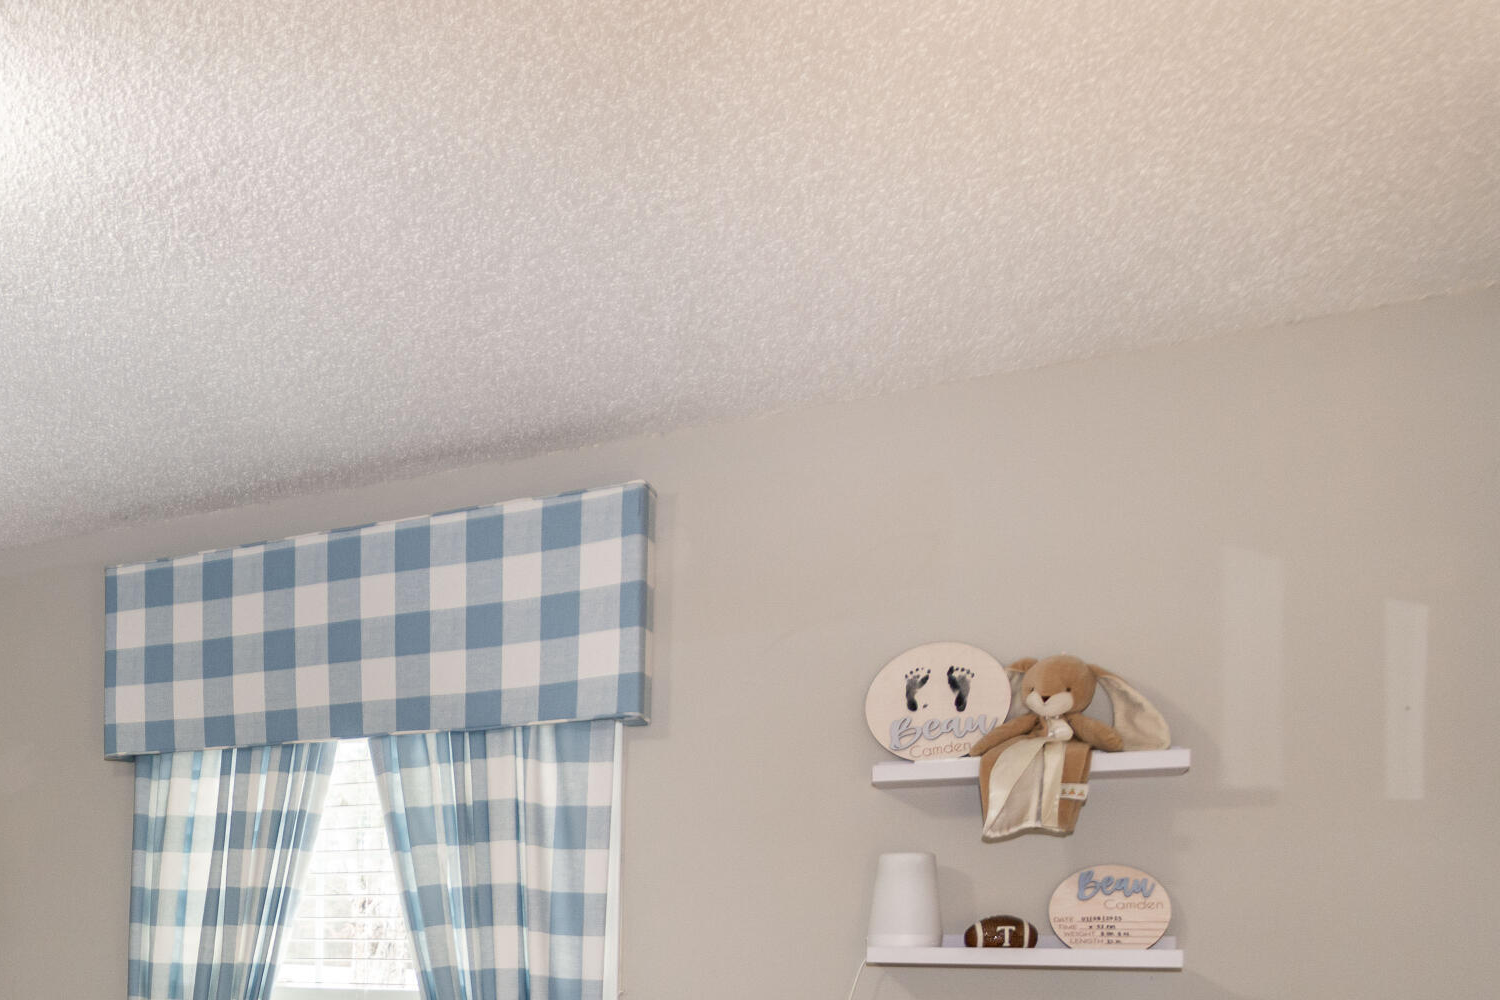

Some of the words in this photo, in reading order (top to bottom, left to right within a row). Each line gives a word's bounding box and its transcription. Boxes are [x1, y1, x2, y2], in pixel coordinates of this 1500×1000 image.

[909, 741, 972, 758] Camden
[1103, 899, 1164, 910] Camden
[996, 926, 1016, 946] T
